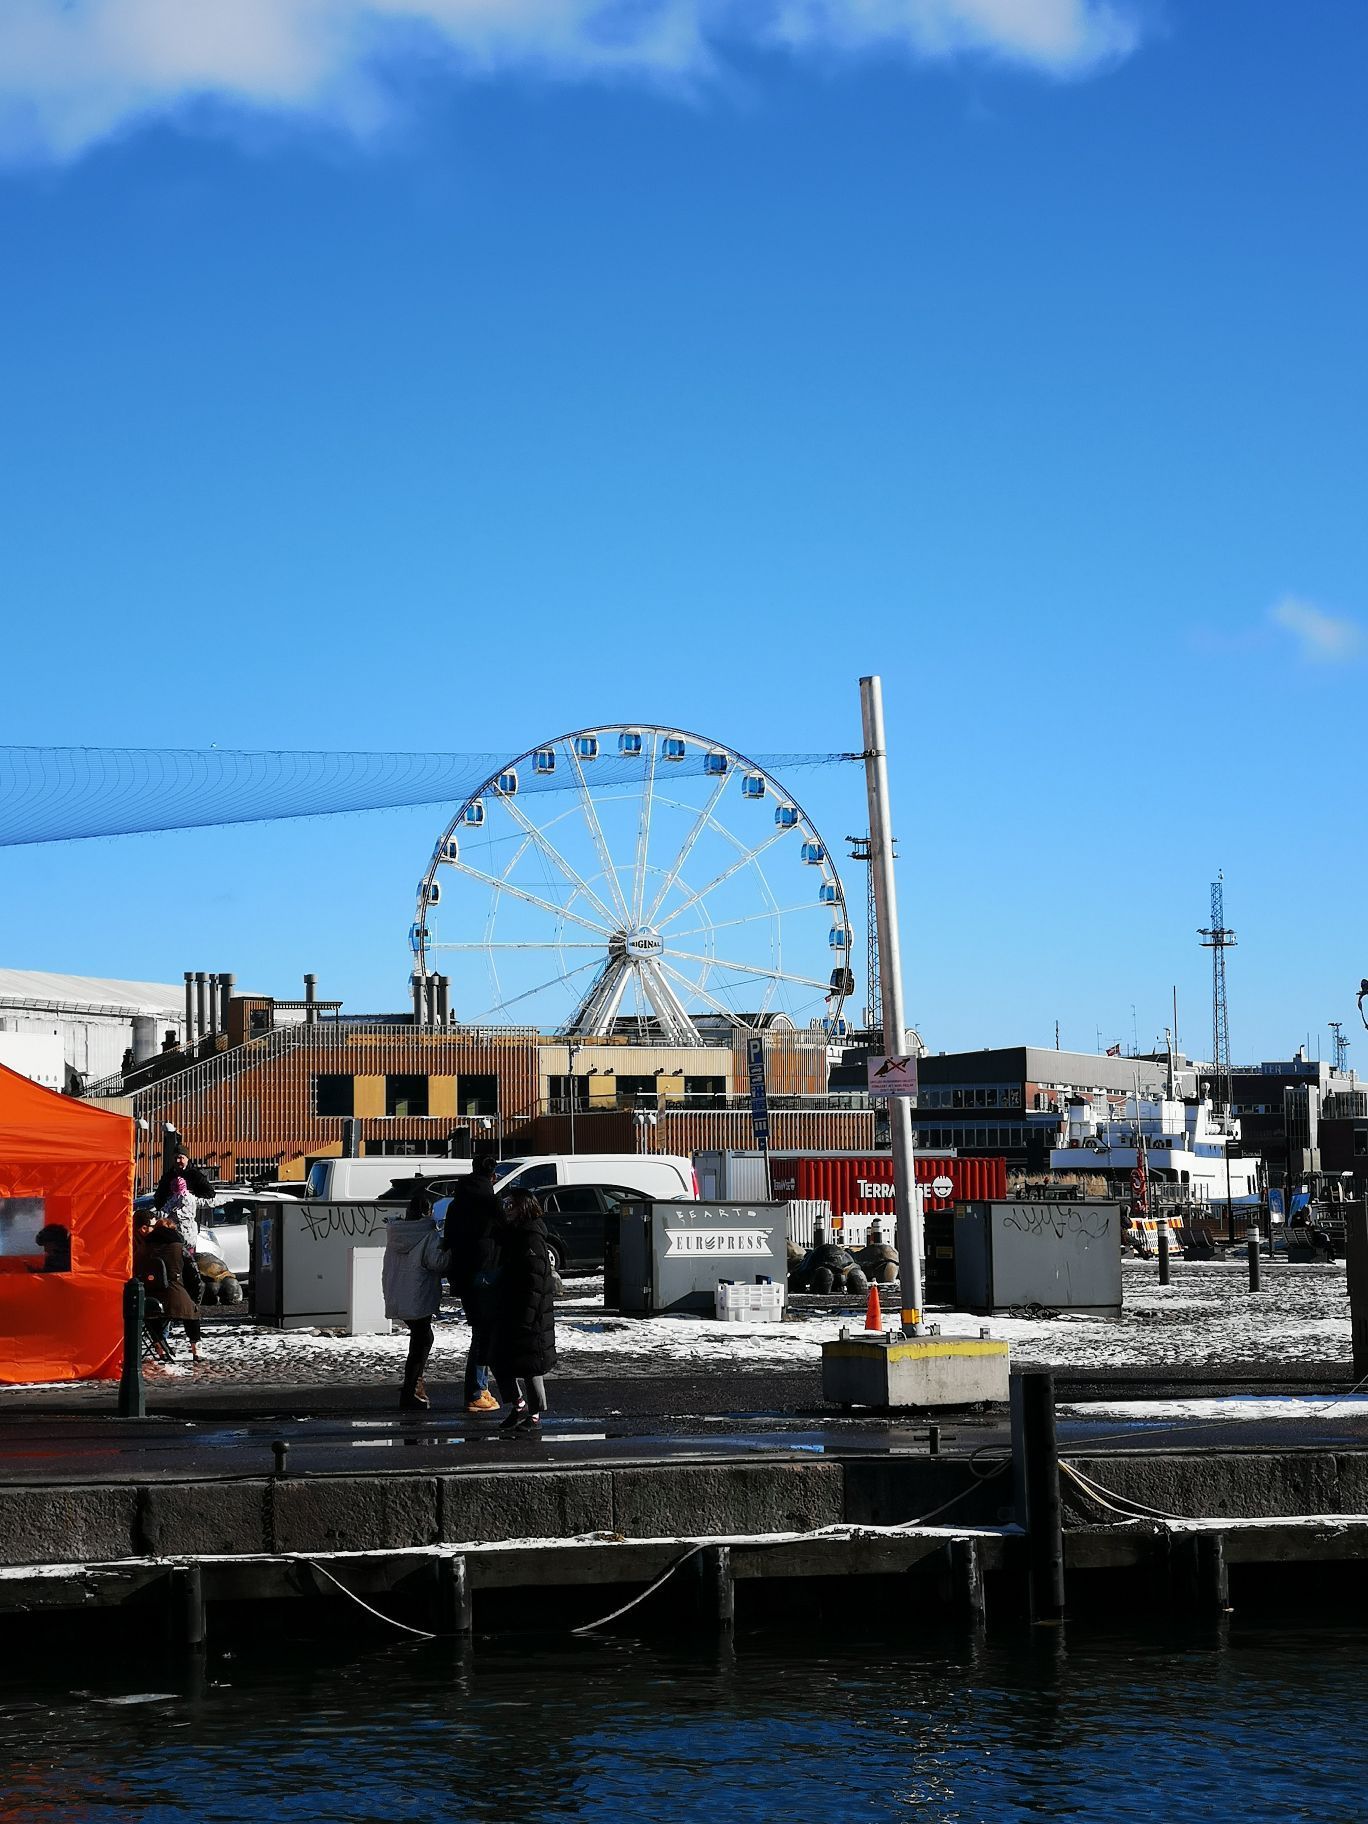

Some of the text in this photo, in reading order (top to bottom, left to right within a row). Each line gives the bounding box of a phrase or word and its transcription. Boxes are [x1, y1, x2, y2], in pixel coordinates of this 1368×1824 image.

[750, 1040, 760, 1062] P
[857, 1179, 932, 1198] TERRAE
[676, 1235, 762, 1250] EUROPRESS
